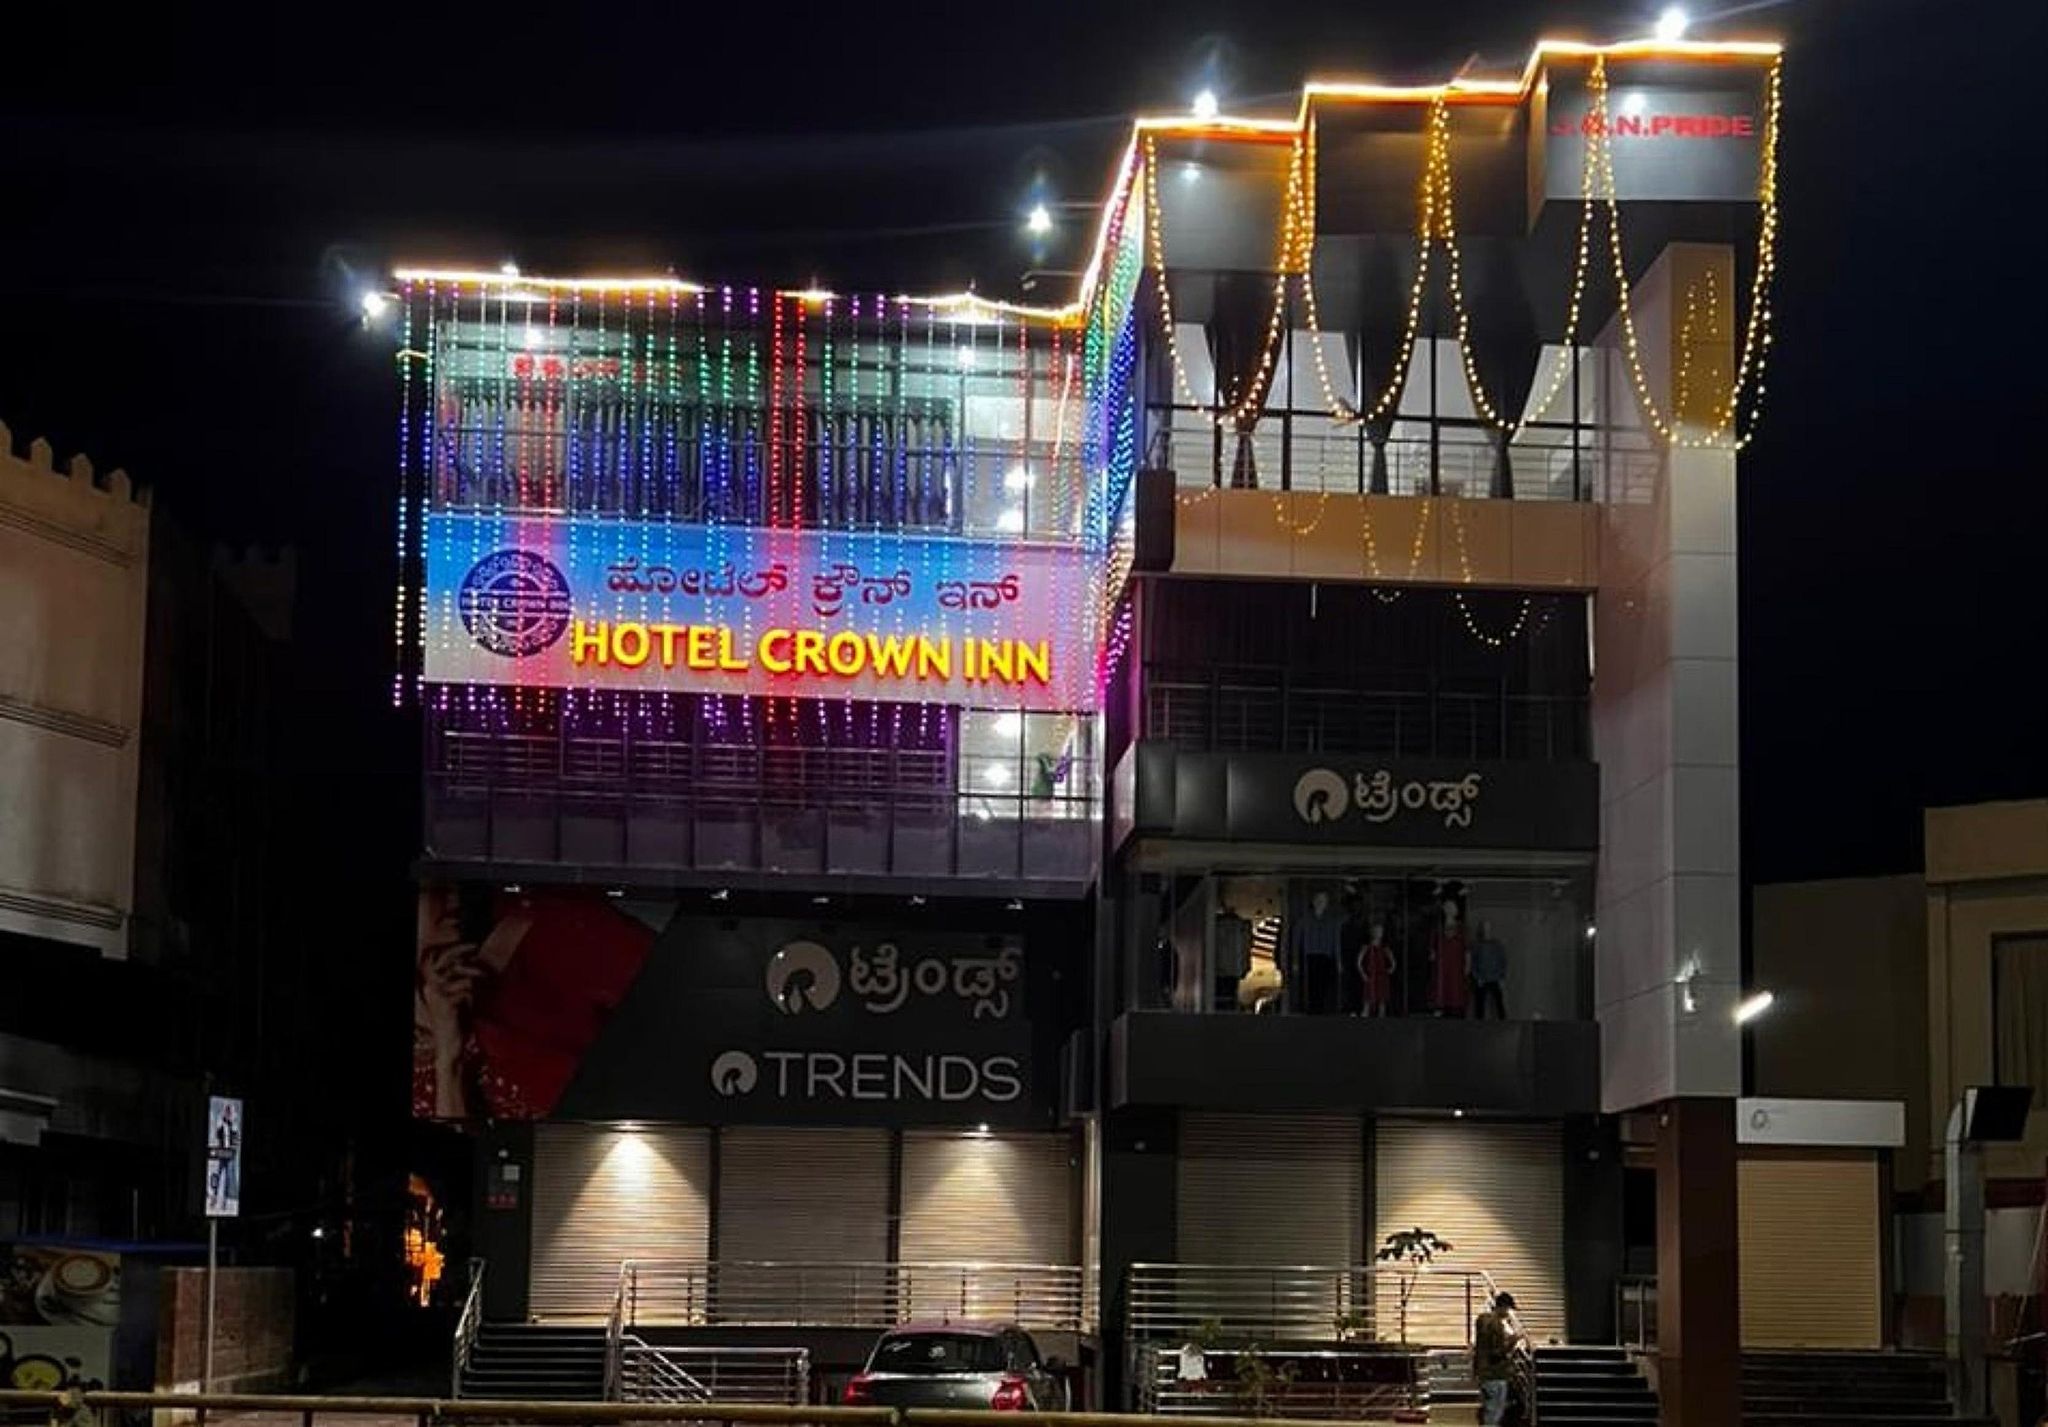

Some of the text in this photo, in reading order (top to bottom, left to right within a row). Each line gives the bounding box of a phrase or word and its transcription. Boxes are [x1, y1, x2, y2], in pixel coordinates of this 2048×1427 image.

[606, 556, 789, 598] ಹೋಟೆಲ್
[812, 564, 912, 617] ಕ್ರೌನ್
[936, 574, 1020, 611] ಇನ್
[572, 619, 748, 671] HOTEL
[759, 628, 951, 681] CROWN
[964, 637, 1051, 685] INN
[764, 1051, 1022, 1102] TRENDS
